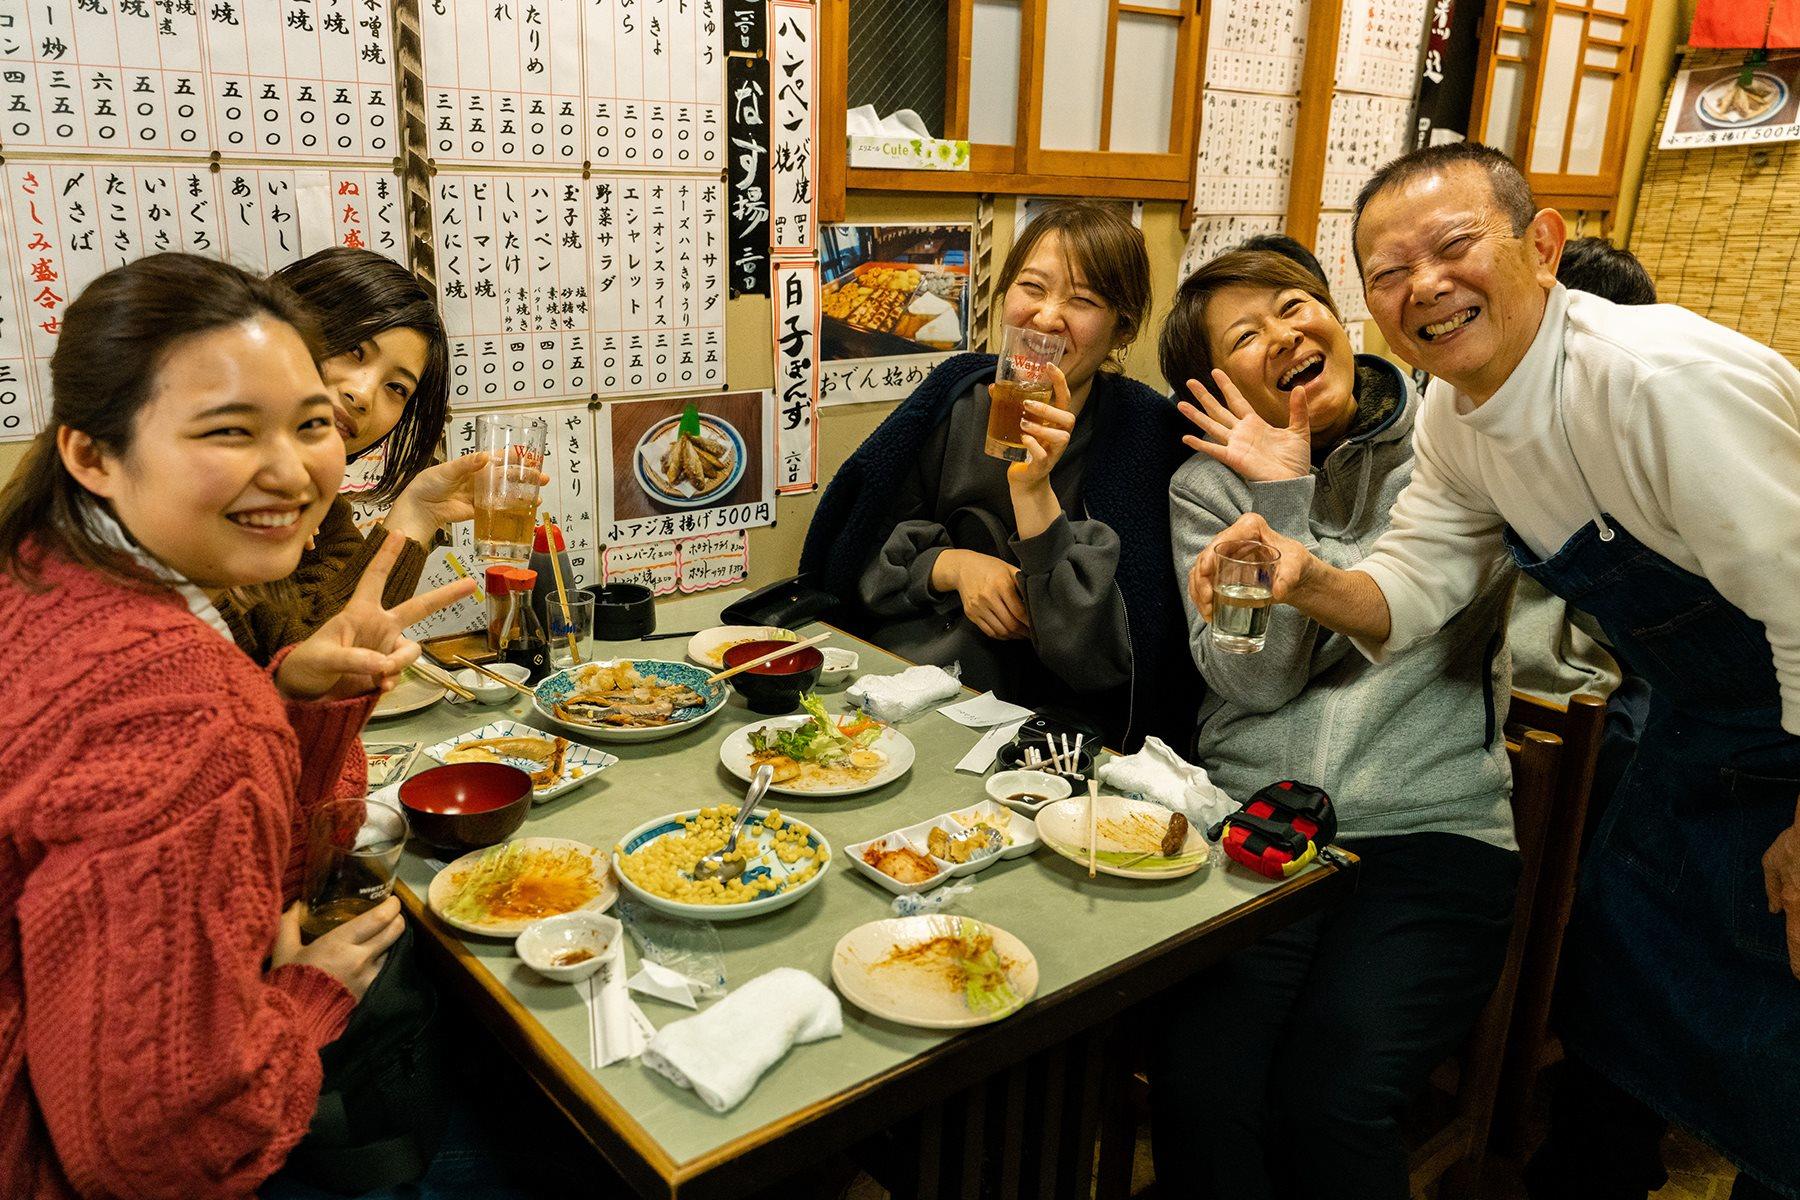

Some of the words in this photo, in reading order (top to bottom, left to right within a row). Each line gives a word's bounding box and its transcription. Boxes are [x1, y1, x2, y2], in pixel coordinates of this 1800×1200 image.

[211, 2, 239, 26] 焼
[882, 143, 909, 156] Cute
[187, 173, 210, 250] まぐろ
[231, 176, 254, 226] あじ
[268, 180, 291, 251] いわし
[375, 177, 395, 249] まぐろ
[473, 183, 497, 298] ピーマン焼
[502, 182, 520, 274] しいたけ
[531, 188, 552, 272] ハンペン
[562, 184, 582, 249] 玉子焼
[596, 184, 616, 292] 野菜サラダ
[22, 171, 64, 335] さしみ盛合せ
[441, 184, 468, 299] にんにく焼
[624, 188, 641, 315] エシャレット
[652, 185, 667, 326] オニオンスライス
[679, 185, 692, 327] チーズハムきゅうり
[701, 185, 720, 311] ポテトサラダ
[516, 287, 530, 332] 素焼き
[546, 286, 561, 330] 素焼き
[561, 287, 576, 329] 砂糖味
[575, 286, 588, 314] 塩味
[777, 272, 813, 431] 白子ぽんず
[565, 416, 581, 497] やきとり
[608, 502, 769, 541] 小アジ唐揚げ500円
